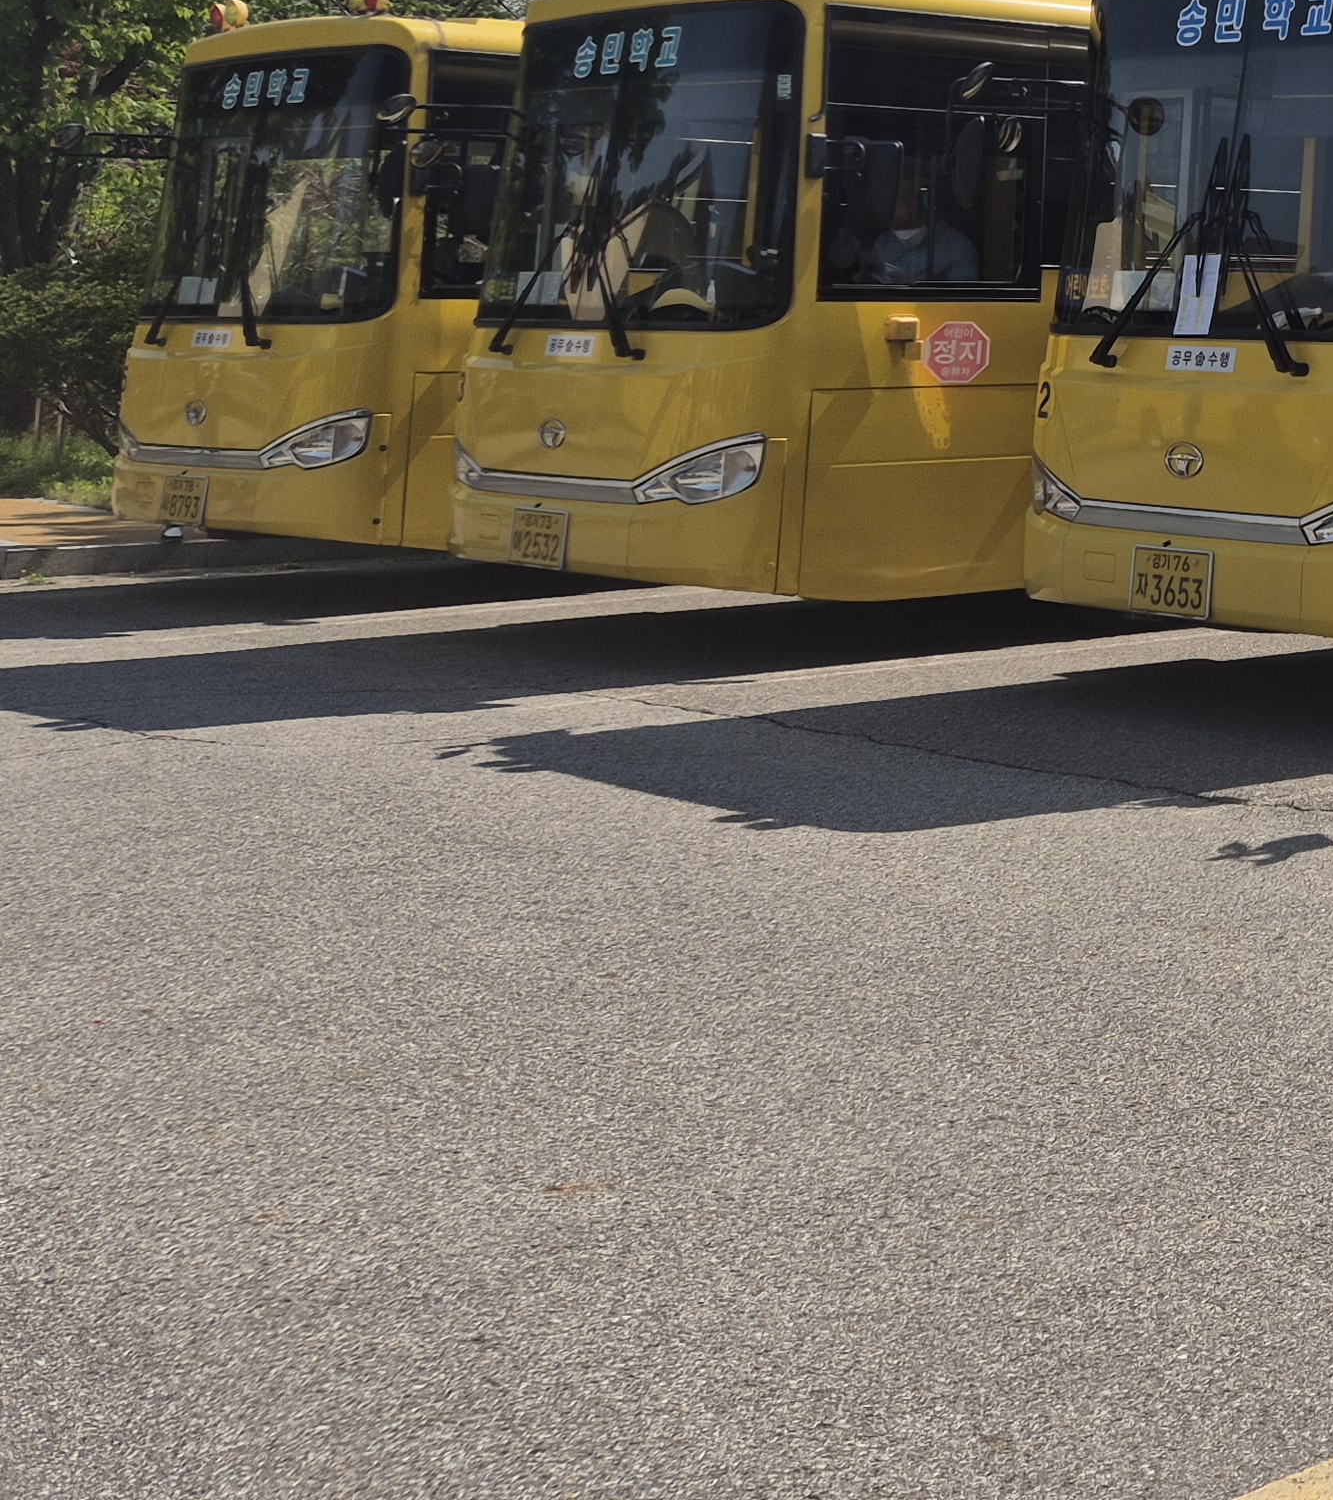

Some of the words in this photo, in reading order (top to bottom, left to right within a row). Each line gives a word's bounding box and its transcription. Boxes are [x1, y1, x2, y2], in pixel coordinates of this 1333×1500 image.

[573, 26, 682, 79] 송민학교
[222, 68, 310, 110] 송민학교
[944, 328, 973, 338] 어린이
[933, 340, 983, 365] 정지
[1172, 351, 1192, 366] 공무
[1208, 351, 1231, 368] 수행
[1037, 381, 1051, 419] 2
[1135, 572, 1204, 610] 자3653
